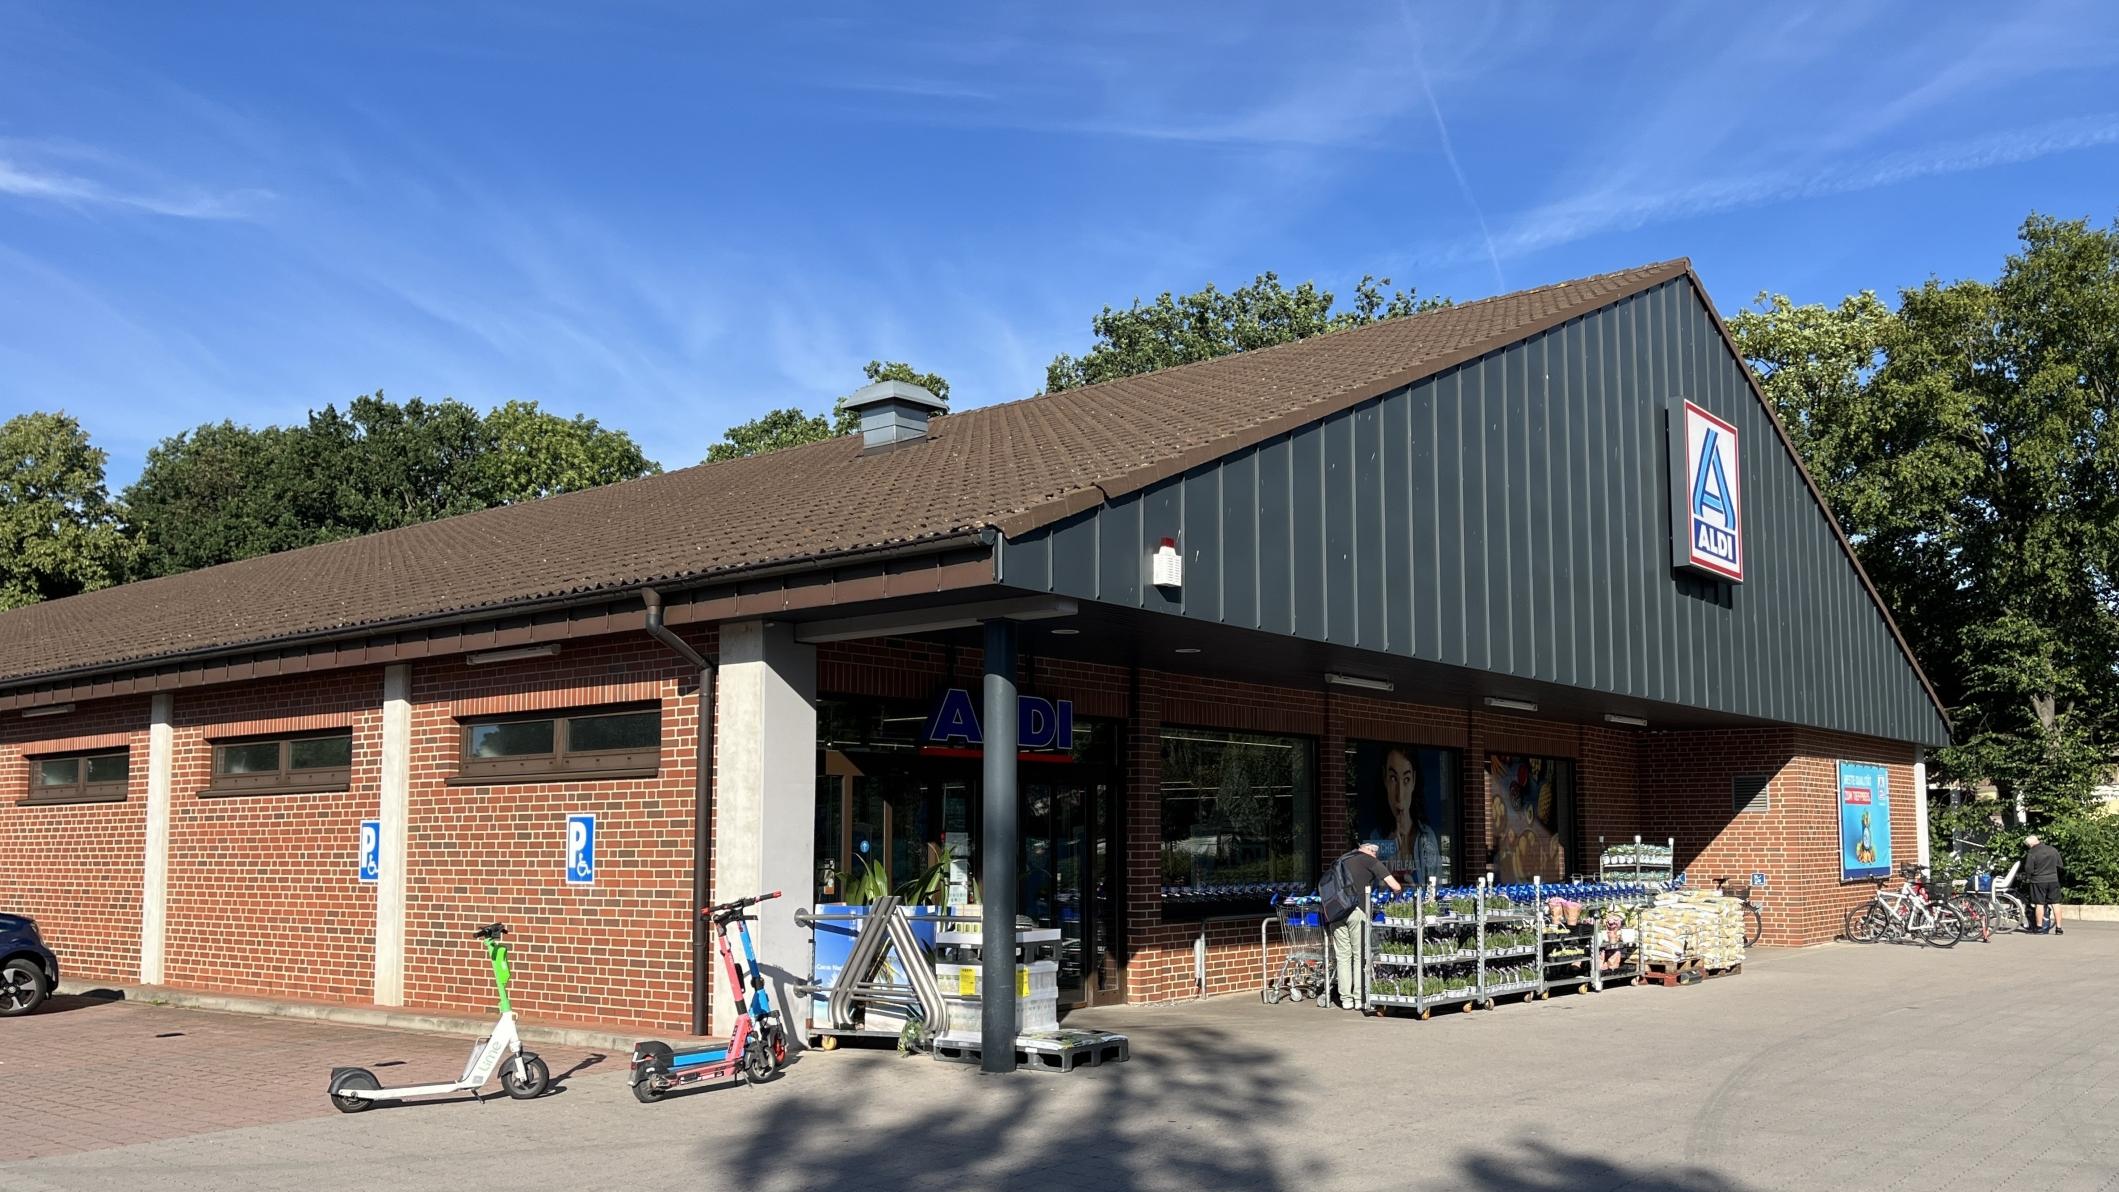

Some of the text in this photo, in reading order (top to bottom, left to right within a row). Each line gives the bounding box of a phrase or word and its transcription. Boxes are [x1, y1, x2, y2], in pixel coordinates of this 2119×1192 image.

[1698, 525, 1733, 560] ALDI
[930, 688, 1073, 750] ADI
[361, 826, 376, 868] P
[568, 821, 587, 869] P
[479, 1040, 501, 1072] Lime
